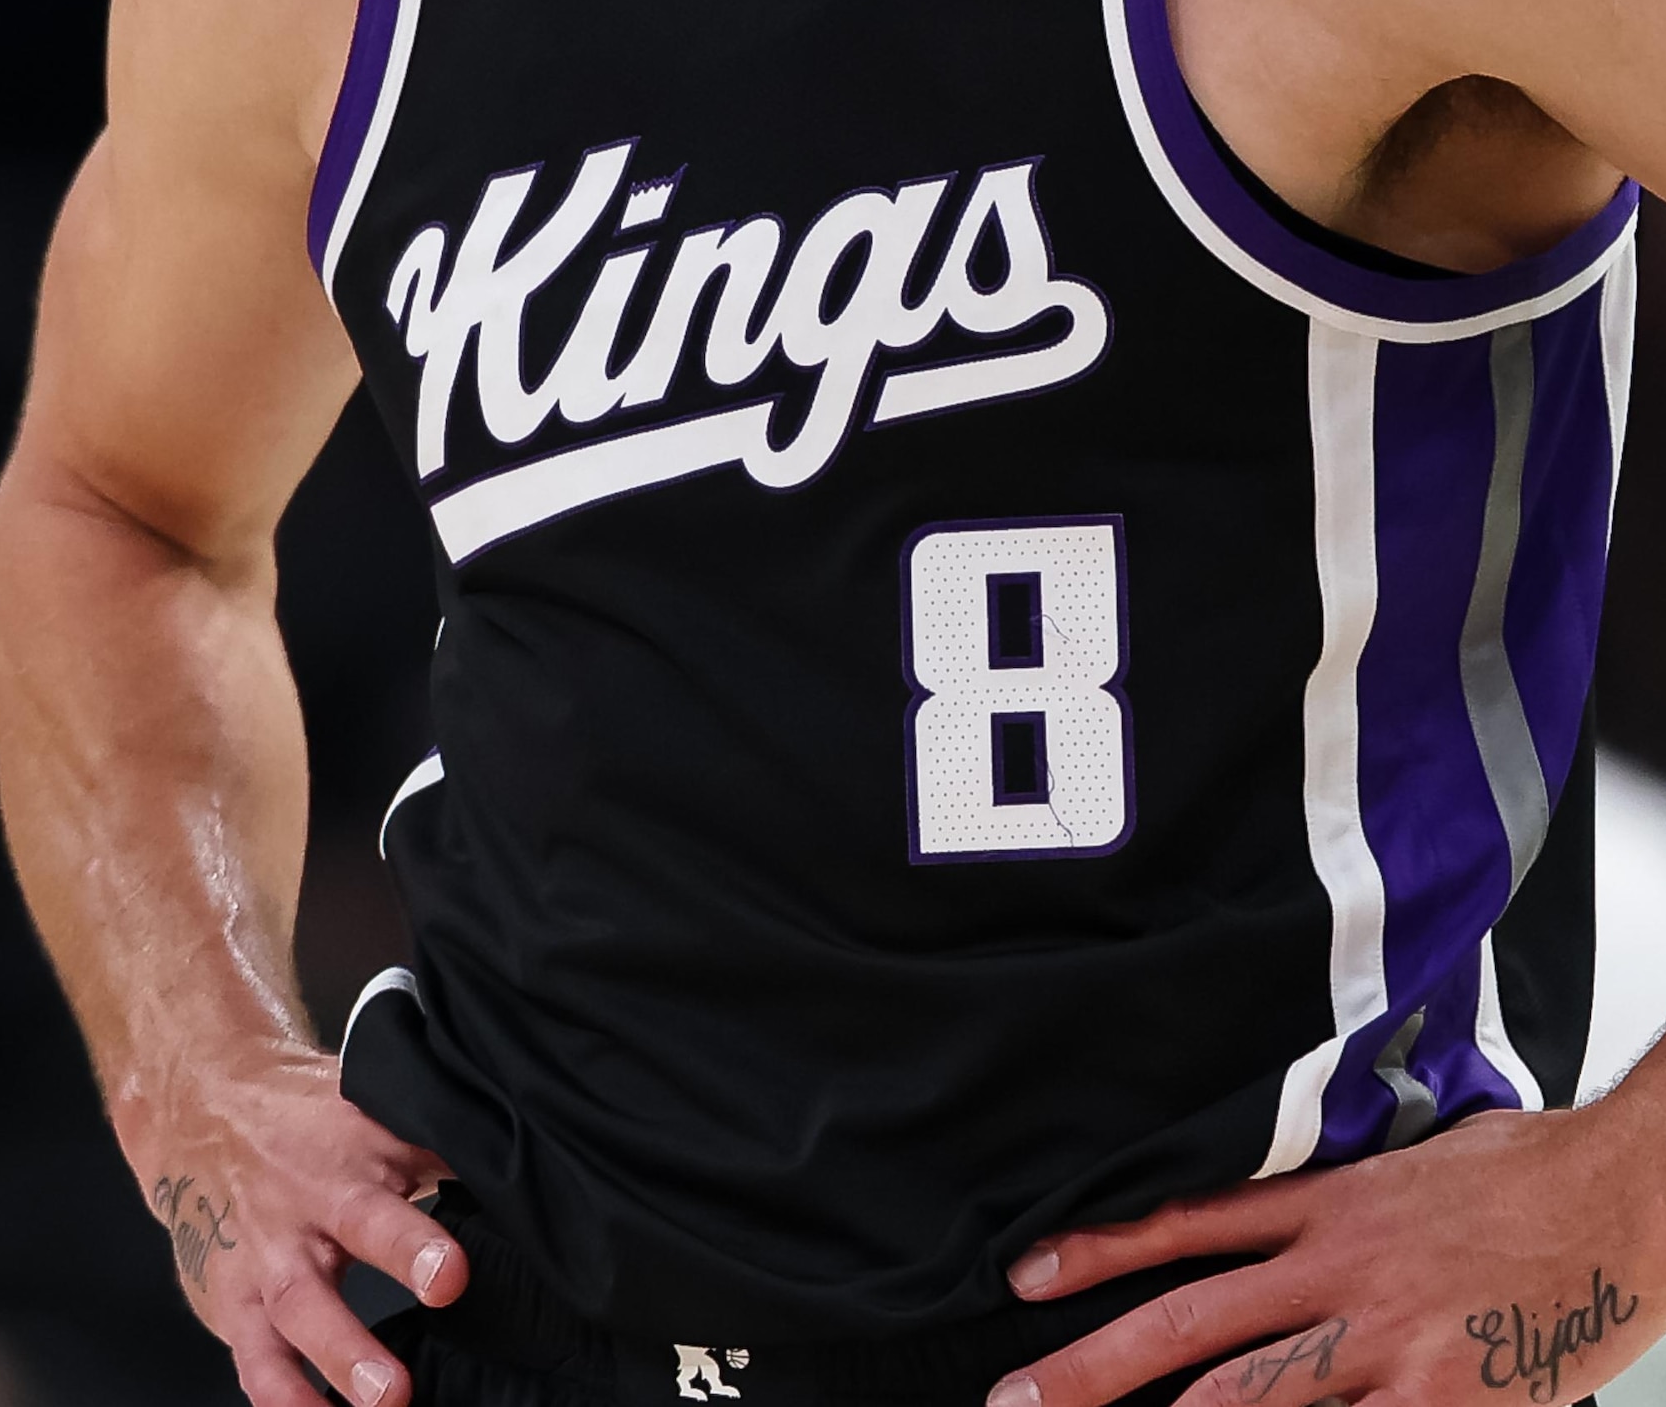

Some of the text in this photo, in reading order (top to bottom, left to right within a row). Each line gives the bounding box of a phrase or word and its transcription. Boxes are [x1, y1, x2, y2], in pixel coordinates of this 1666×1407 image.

[387, 138, 1113, 566] Kings
[900, 513, 1136, 865] 8
[1465, 1266, 1639, 1403] Elijah
